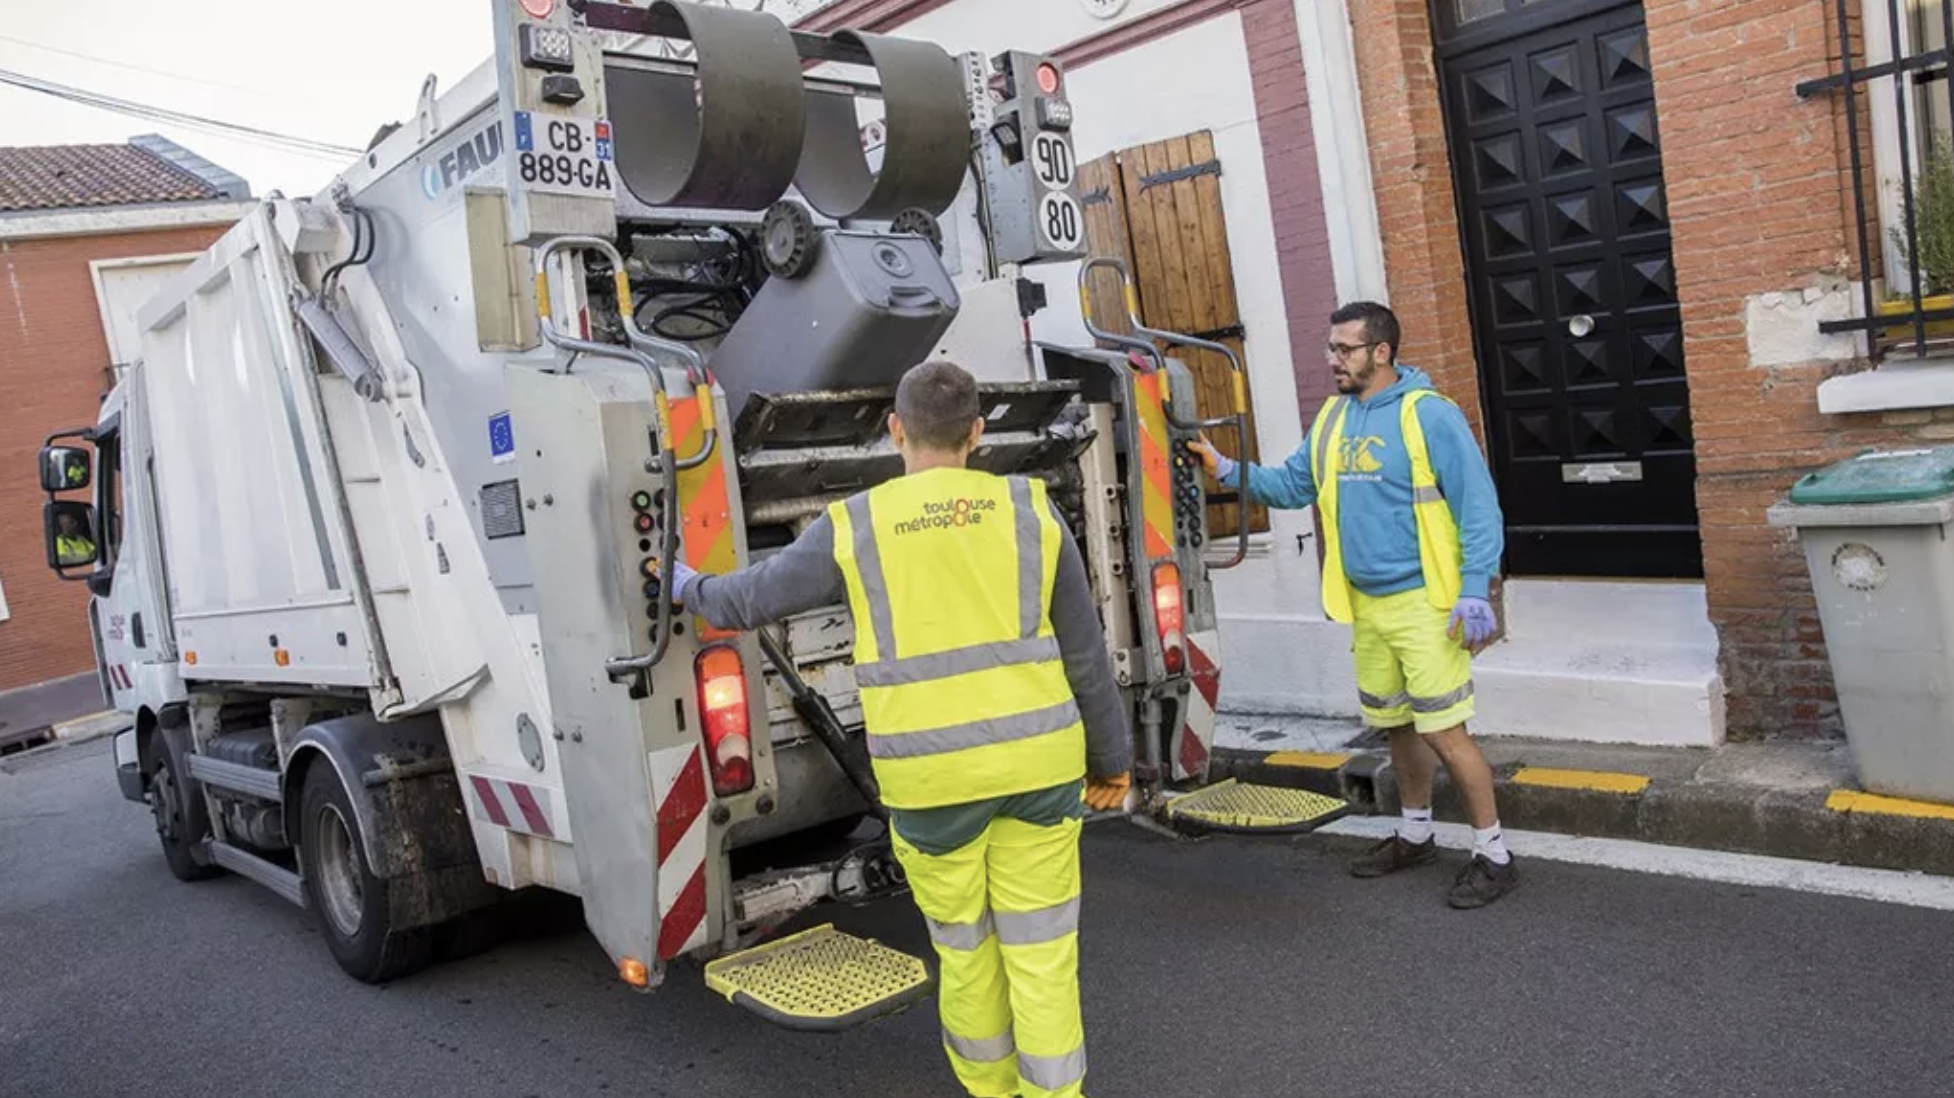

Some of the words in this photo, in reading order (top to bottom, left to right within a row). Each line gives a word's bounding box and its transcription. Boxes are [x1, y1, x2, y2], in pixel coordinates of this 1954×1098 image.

[439, 120, 504, 190] FAU
[596, 140, 611, 160] 31
[1037, 137, 1069, 184] 90
[1047, 199, 1076, 242] 80
[922, 498, 996, 514] toulouse
[894, 511, 982, 535] métropole
